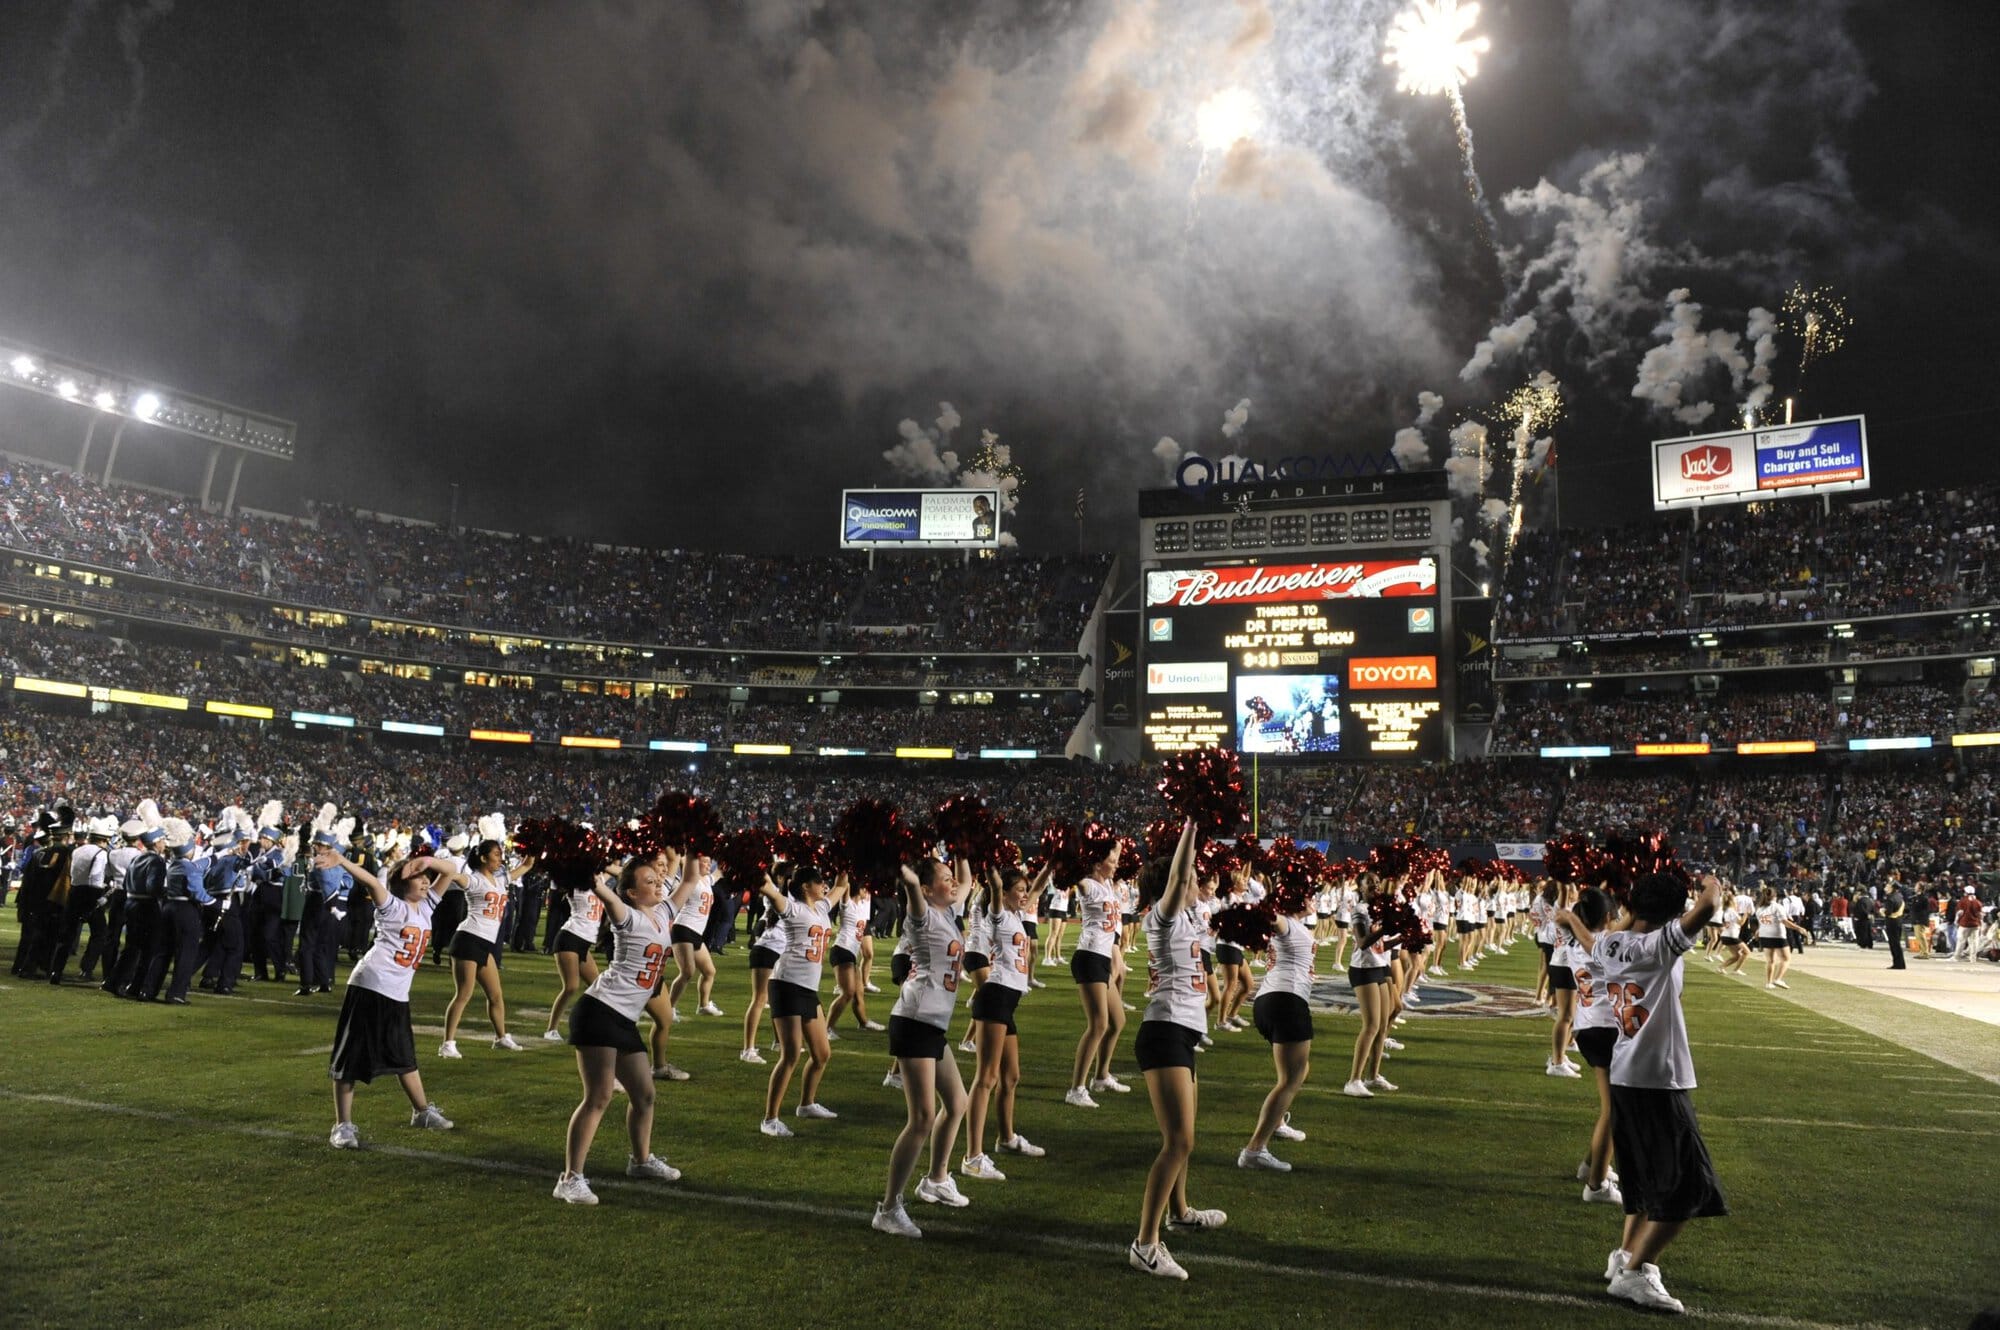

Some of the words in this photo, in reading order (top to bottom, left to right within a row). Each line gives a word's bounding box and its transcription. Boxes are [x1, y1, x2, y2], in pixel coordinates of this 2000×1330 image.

[1776, 449, 1795, 460] Buy
[1798, 445, 1818, 457] and
[1820, 442, 1840, 454] Sell
[1683, 448, 1731, 478] Jack
[1763, 460, 1811, 474] Chargers
[1813, 453, 1855, 468] Tickets!
[1176, 450, 1401, 496] QUALCOMM
[1222, 482, 1384, 501] STADIUM
[849, 506, 917, 522] QUALCOMM
[1172, 563, 1364, 606] Budweiser
[1256, 606, 1298, 617] THANKS
[1302, 605, 1318, 616] TO
[1245, 620, 1266, 632] DR
[1272, 618, 1327, 631] PEPPER
[1225, 633, 1304, 648] HALFTIME
[1313, 631, 1355, 645] SHOW
[1105, 668, 1134, 680] Sprint
[1353, 665, 1432, 682] TOYOTA
[1457, 660, 1490, 673] Sprint
